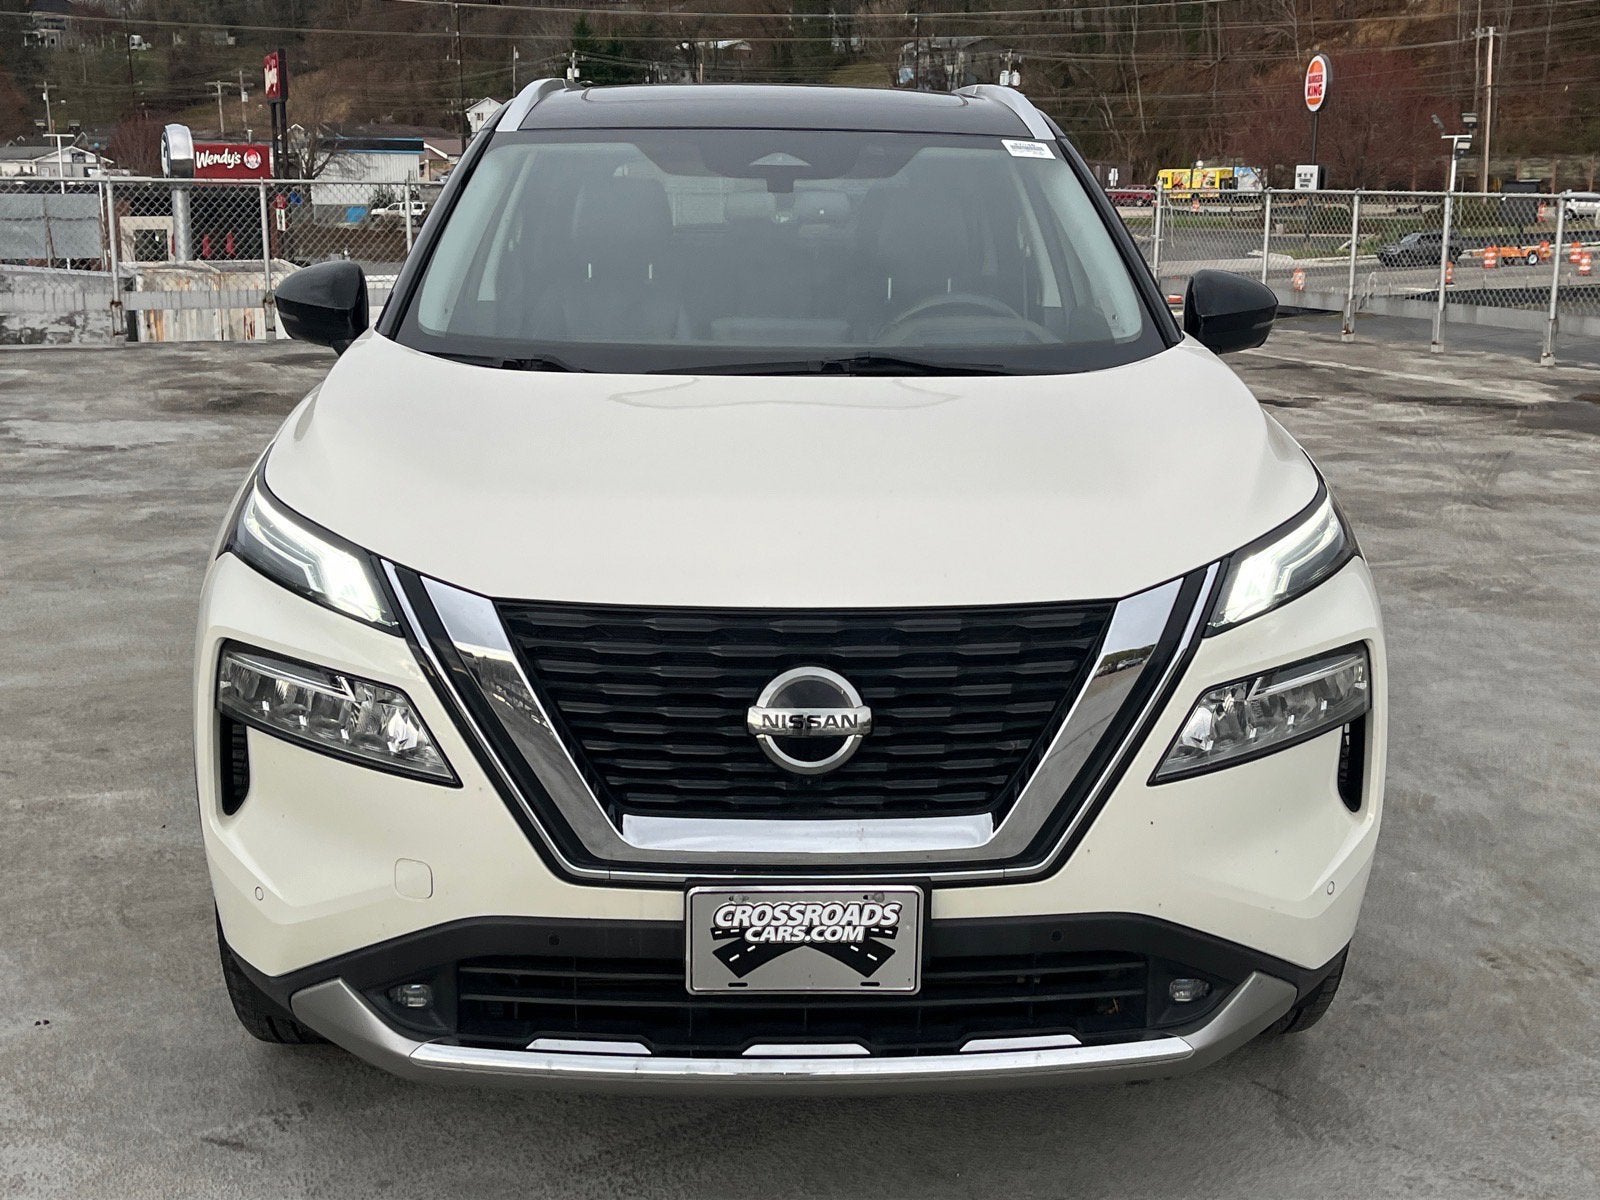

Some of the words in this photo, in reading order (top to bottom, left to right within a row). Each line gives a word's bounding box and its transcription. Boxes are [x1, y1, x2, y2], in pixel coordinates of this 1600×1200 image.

[1307, 83, 1323, 96] KING
[195, 147, 241, 169] Wendy's
[762, 714, 858, 730] NISSAN
[713, 901, 902, 928] CROSSROADS
[744, 925, 866, 943] CARS.COM
